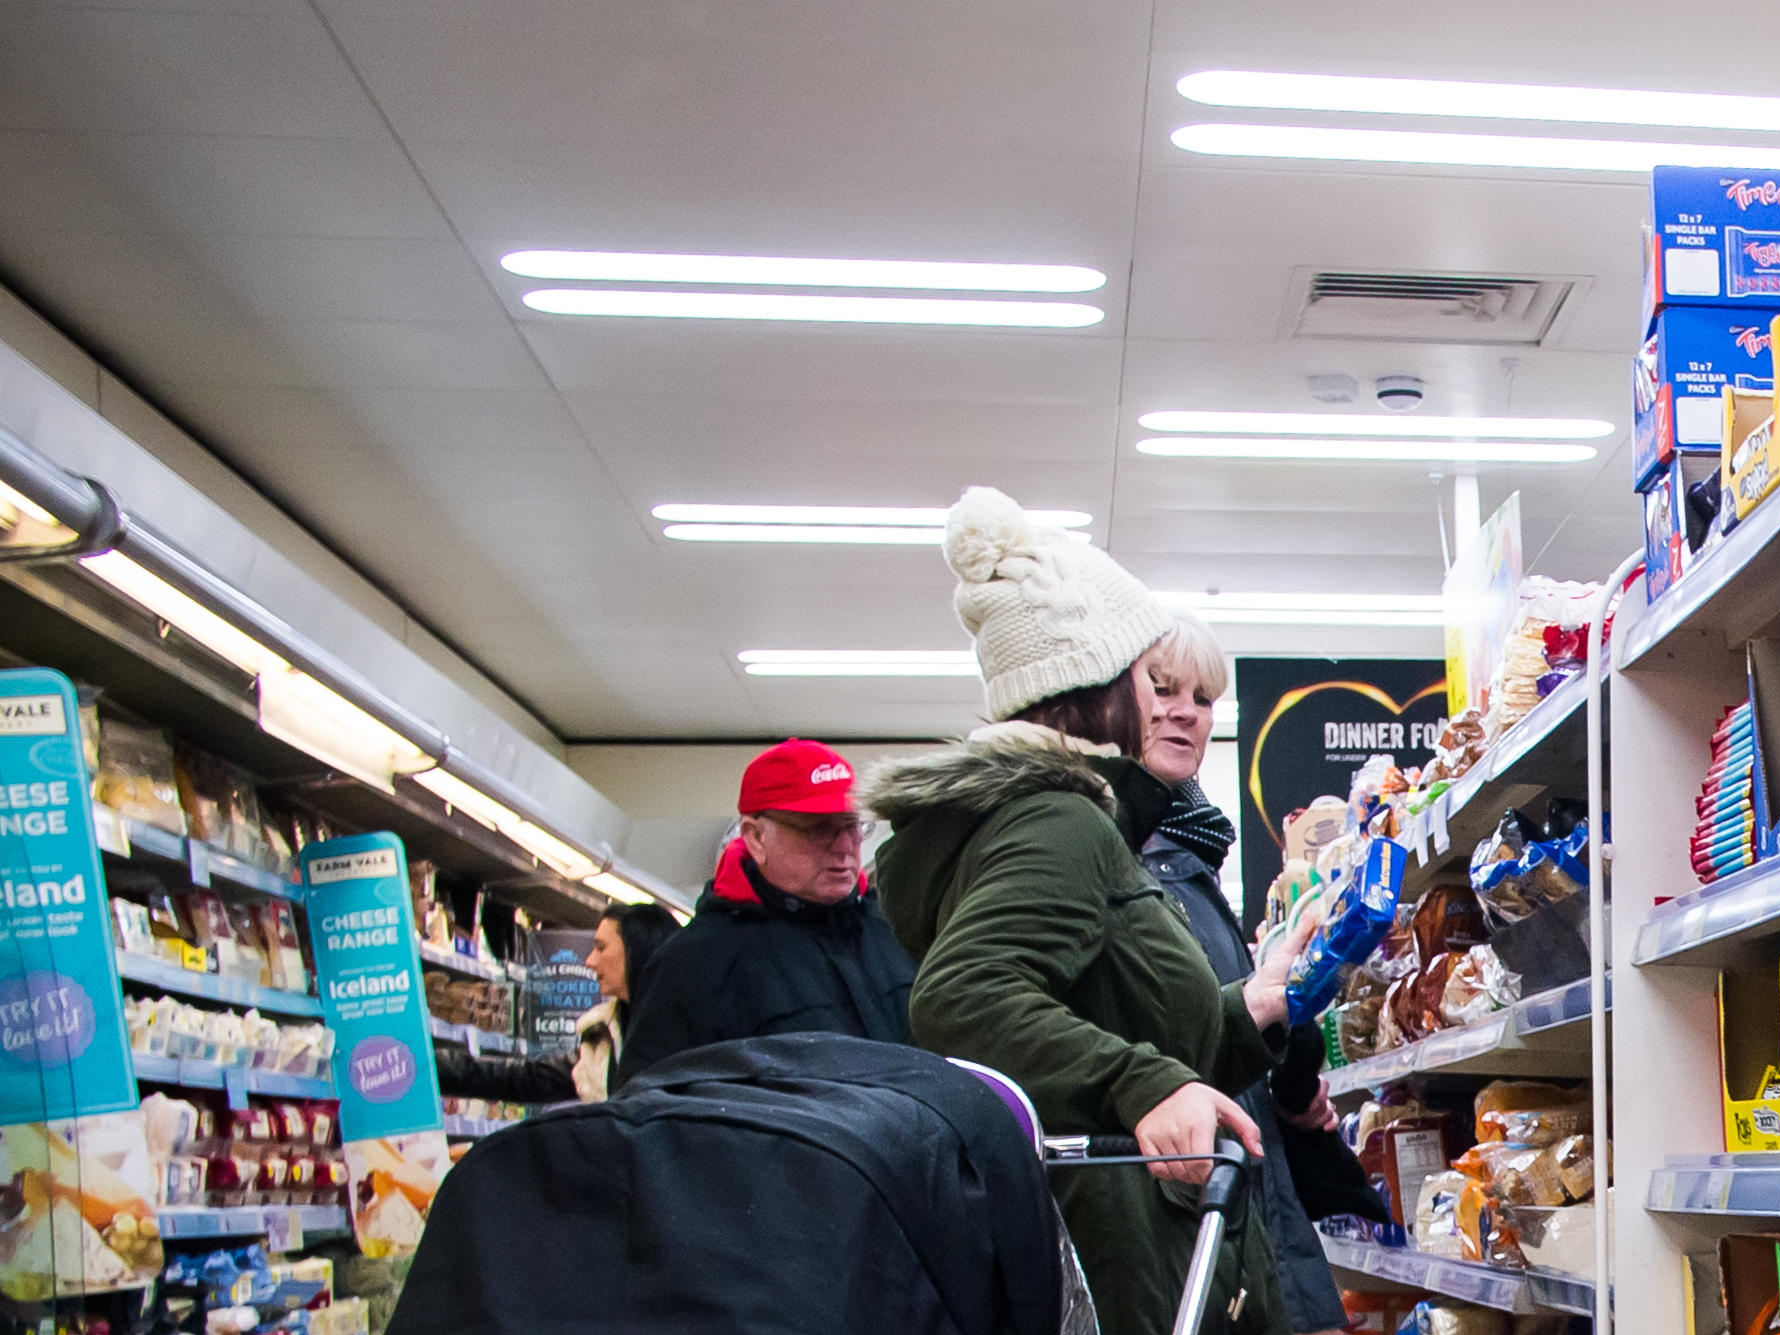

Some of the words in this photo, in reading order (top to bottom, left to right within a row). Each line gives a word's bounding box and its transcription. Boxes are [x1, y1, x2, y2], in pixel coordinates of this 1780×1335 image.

[1664, 224, 1697, 235] SINGLE
[1698, 225, 1716, 236] BAR
[1677, 235, 1706, 245] PACKS
[1675, 373, 1708, 382] SINGLE
[1708, 373, 1727, 383] BAR
[1687, 384, 1716, 394] PACKS
[1324, 721, 1405, 749] DINNER
[0, 781, 69, 809] ESE
[0, 873, 86, 909] land
[321, 906, 399, 933] CHEESE
[327, 926, 398, 951] RANGE
[329, 969, 410, 1000] Iceland
[535, 1016, 576, 1034] Icela
[355, 1053, 385, 1077] TRY
[386, 1044, 402, 1065] IT
